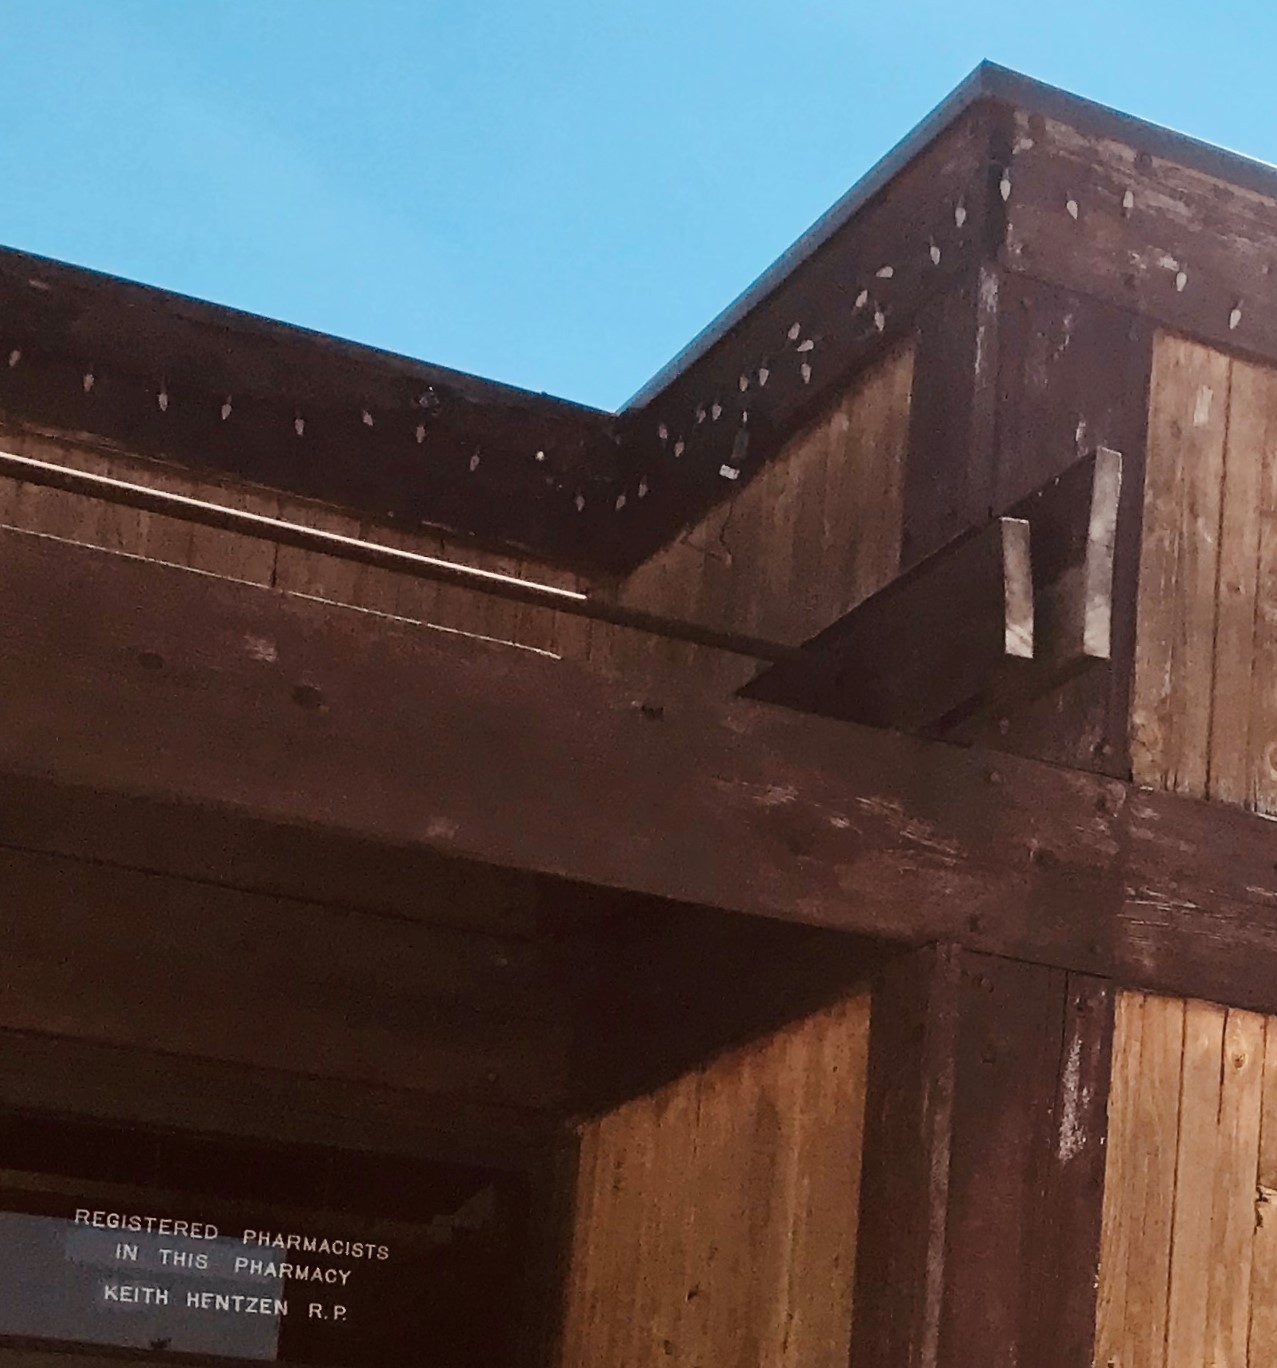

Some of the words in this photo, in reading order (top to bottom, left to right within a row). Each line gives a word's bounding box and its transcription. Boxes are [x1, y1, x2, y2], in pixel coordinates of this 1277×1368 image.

[74, 1208, 219, 1240] REGISTERED
[243, 1229, 390, 1260] PHARMACISTS
[115, 1243, 138, 1262] IN
[159, 1248, 209, 1270] THIS
[234, 1257, 352, 1286] PHARMACY
[104, 1285, 169, 1306] KEITH
[187, 1292, 289, 1316] HENTZEN
